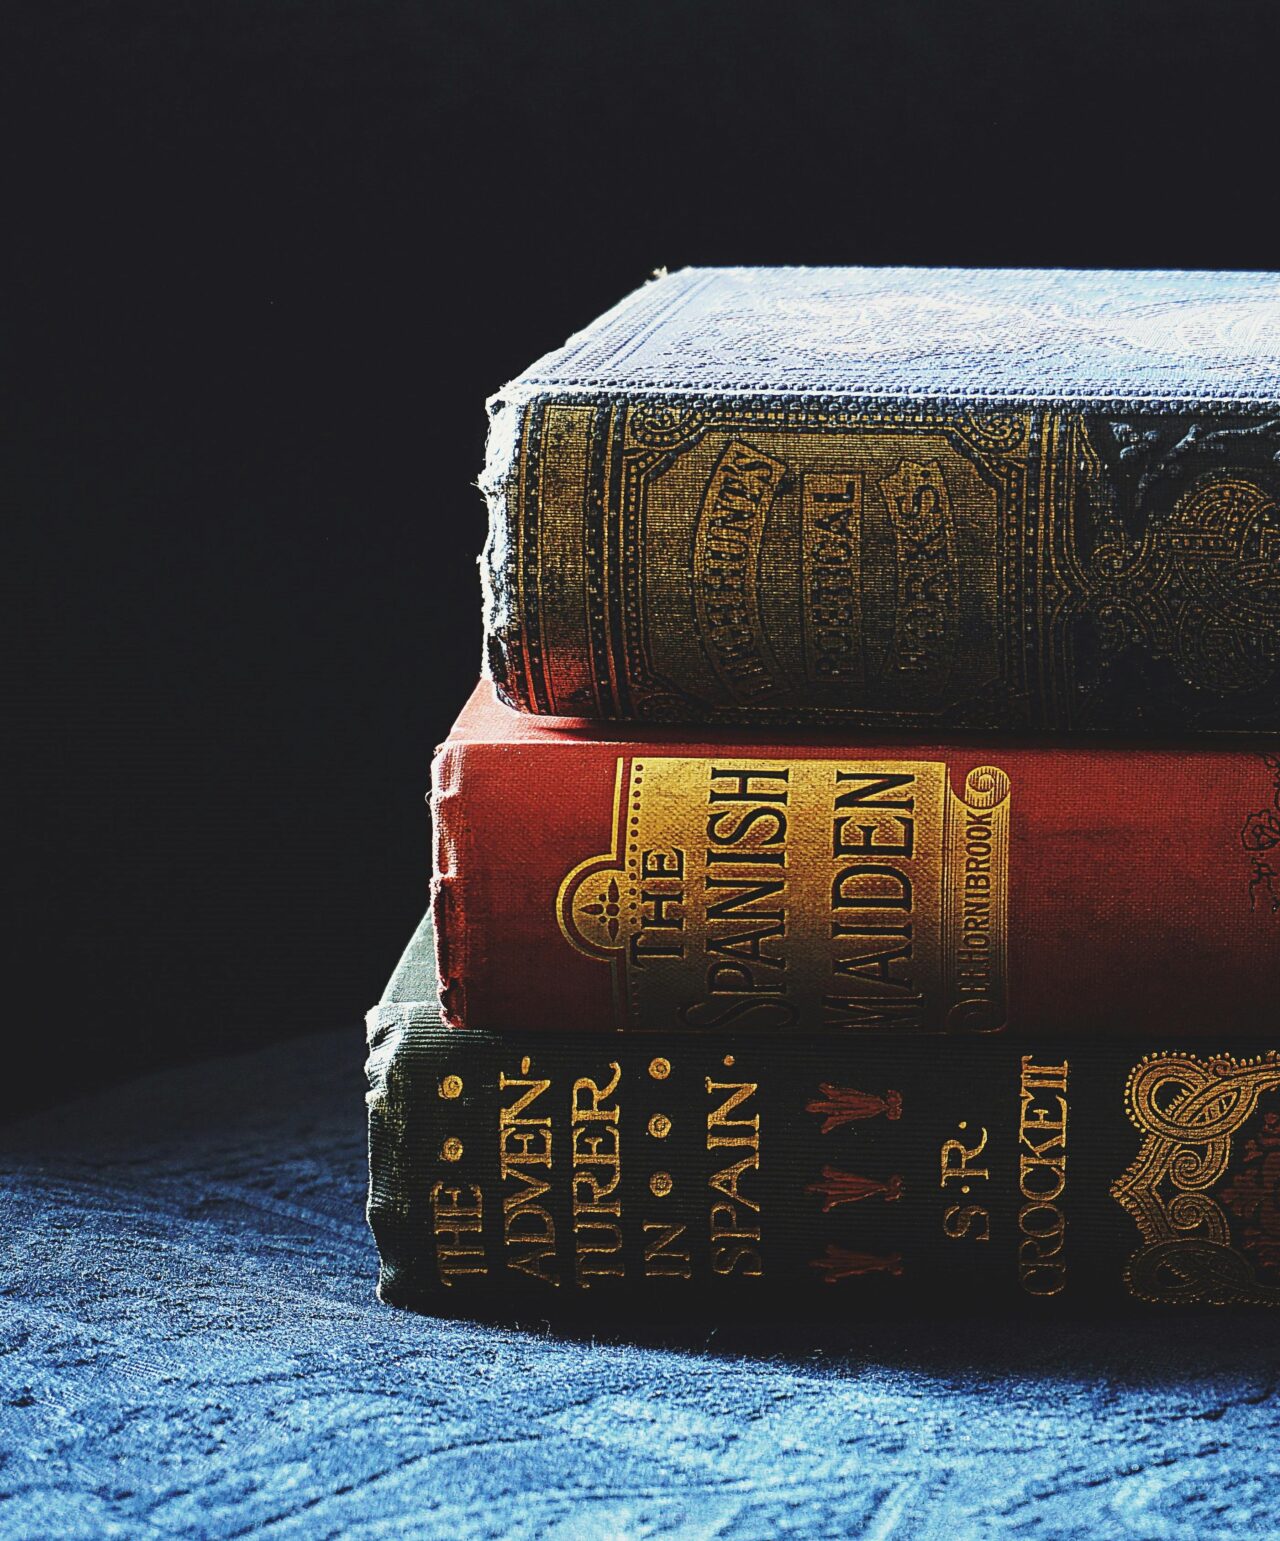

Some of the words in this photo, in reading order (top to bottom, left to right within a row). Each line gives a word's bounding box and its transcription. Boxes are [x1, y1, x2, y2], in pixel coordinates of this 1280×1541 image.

[810, 481, 855, 677] POETICAL
[630, 847, 685, 969] THE
[677, 767, 802, 1030] SPANISH
[821, 769, 925, 1030] MAIDEN
[430, 1180, 489, 1287] THE
[500, 1055, 561, 1288] ADVEN-
[571, 1060, 625, 1288] TURER
[641, 1220, 692, 1279] IN
[1018, 1054, 1069, 1296] CROCKETT
